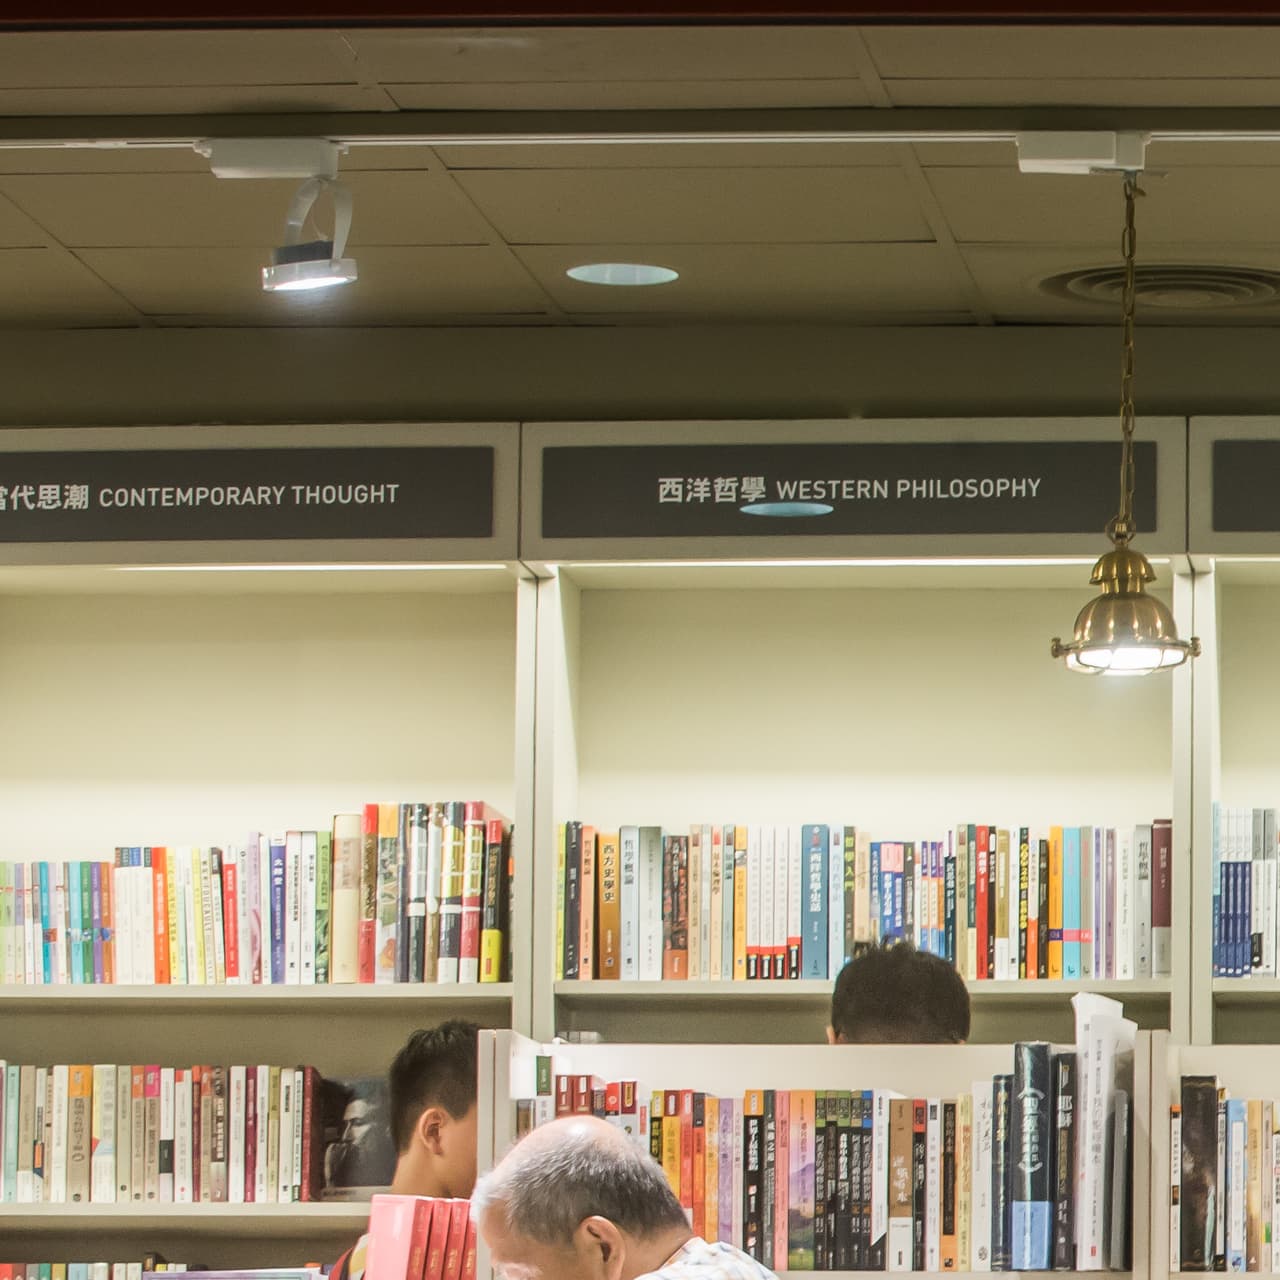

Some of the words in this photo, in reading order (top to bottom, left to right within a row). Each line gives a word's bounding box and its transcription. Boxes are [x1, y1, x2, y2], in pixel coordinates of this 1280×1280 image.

[99, 485, 286, 508] CONTEMPORARY
[290, 483, 400, 505] THOUGHT
[656, 476, 766, 503] 西洋哲學
[776, 480, 889, 502] WESTERN
[896, 478, 1041, 500] PHILOSOPHY
[602, 844, 616, 902] 西方史學史
